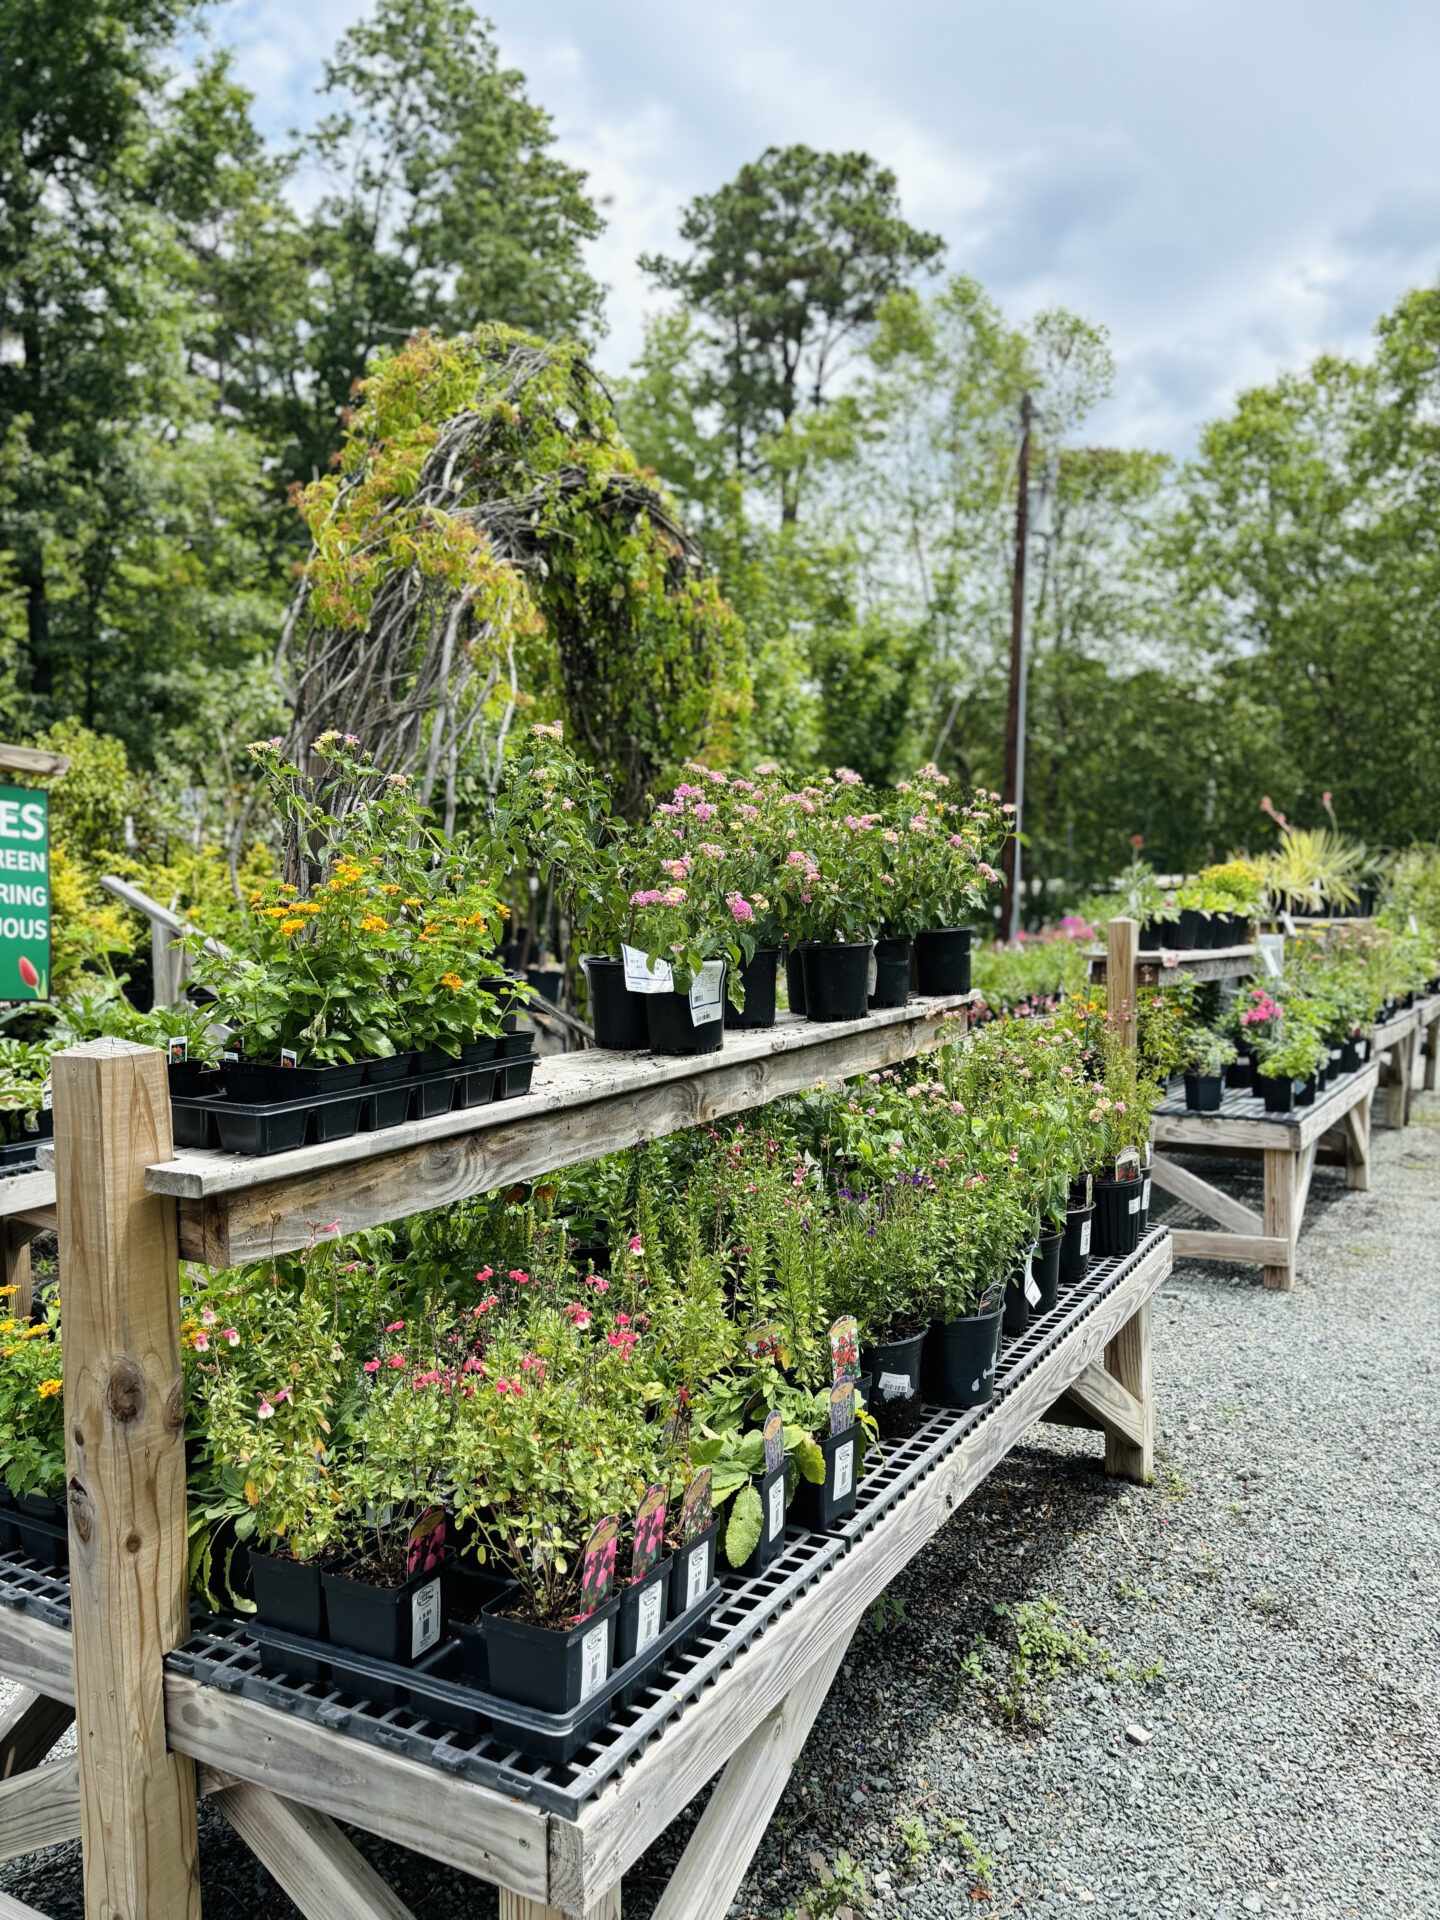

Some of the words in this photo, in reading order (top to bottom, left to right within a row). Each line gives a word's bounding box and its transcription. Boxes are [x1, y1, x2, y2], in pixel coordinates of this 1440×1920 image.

[0, 800, 45, 841] ES
[0, 883, 47, 907] RING
[0, 916, 47, 940] OUS
